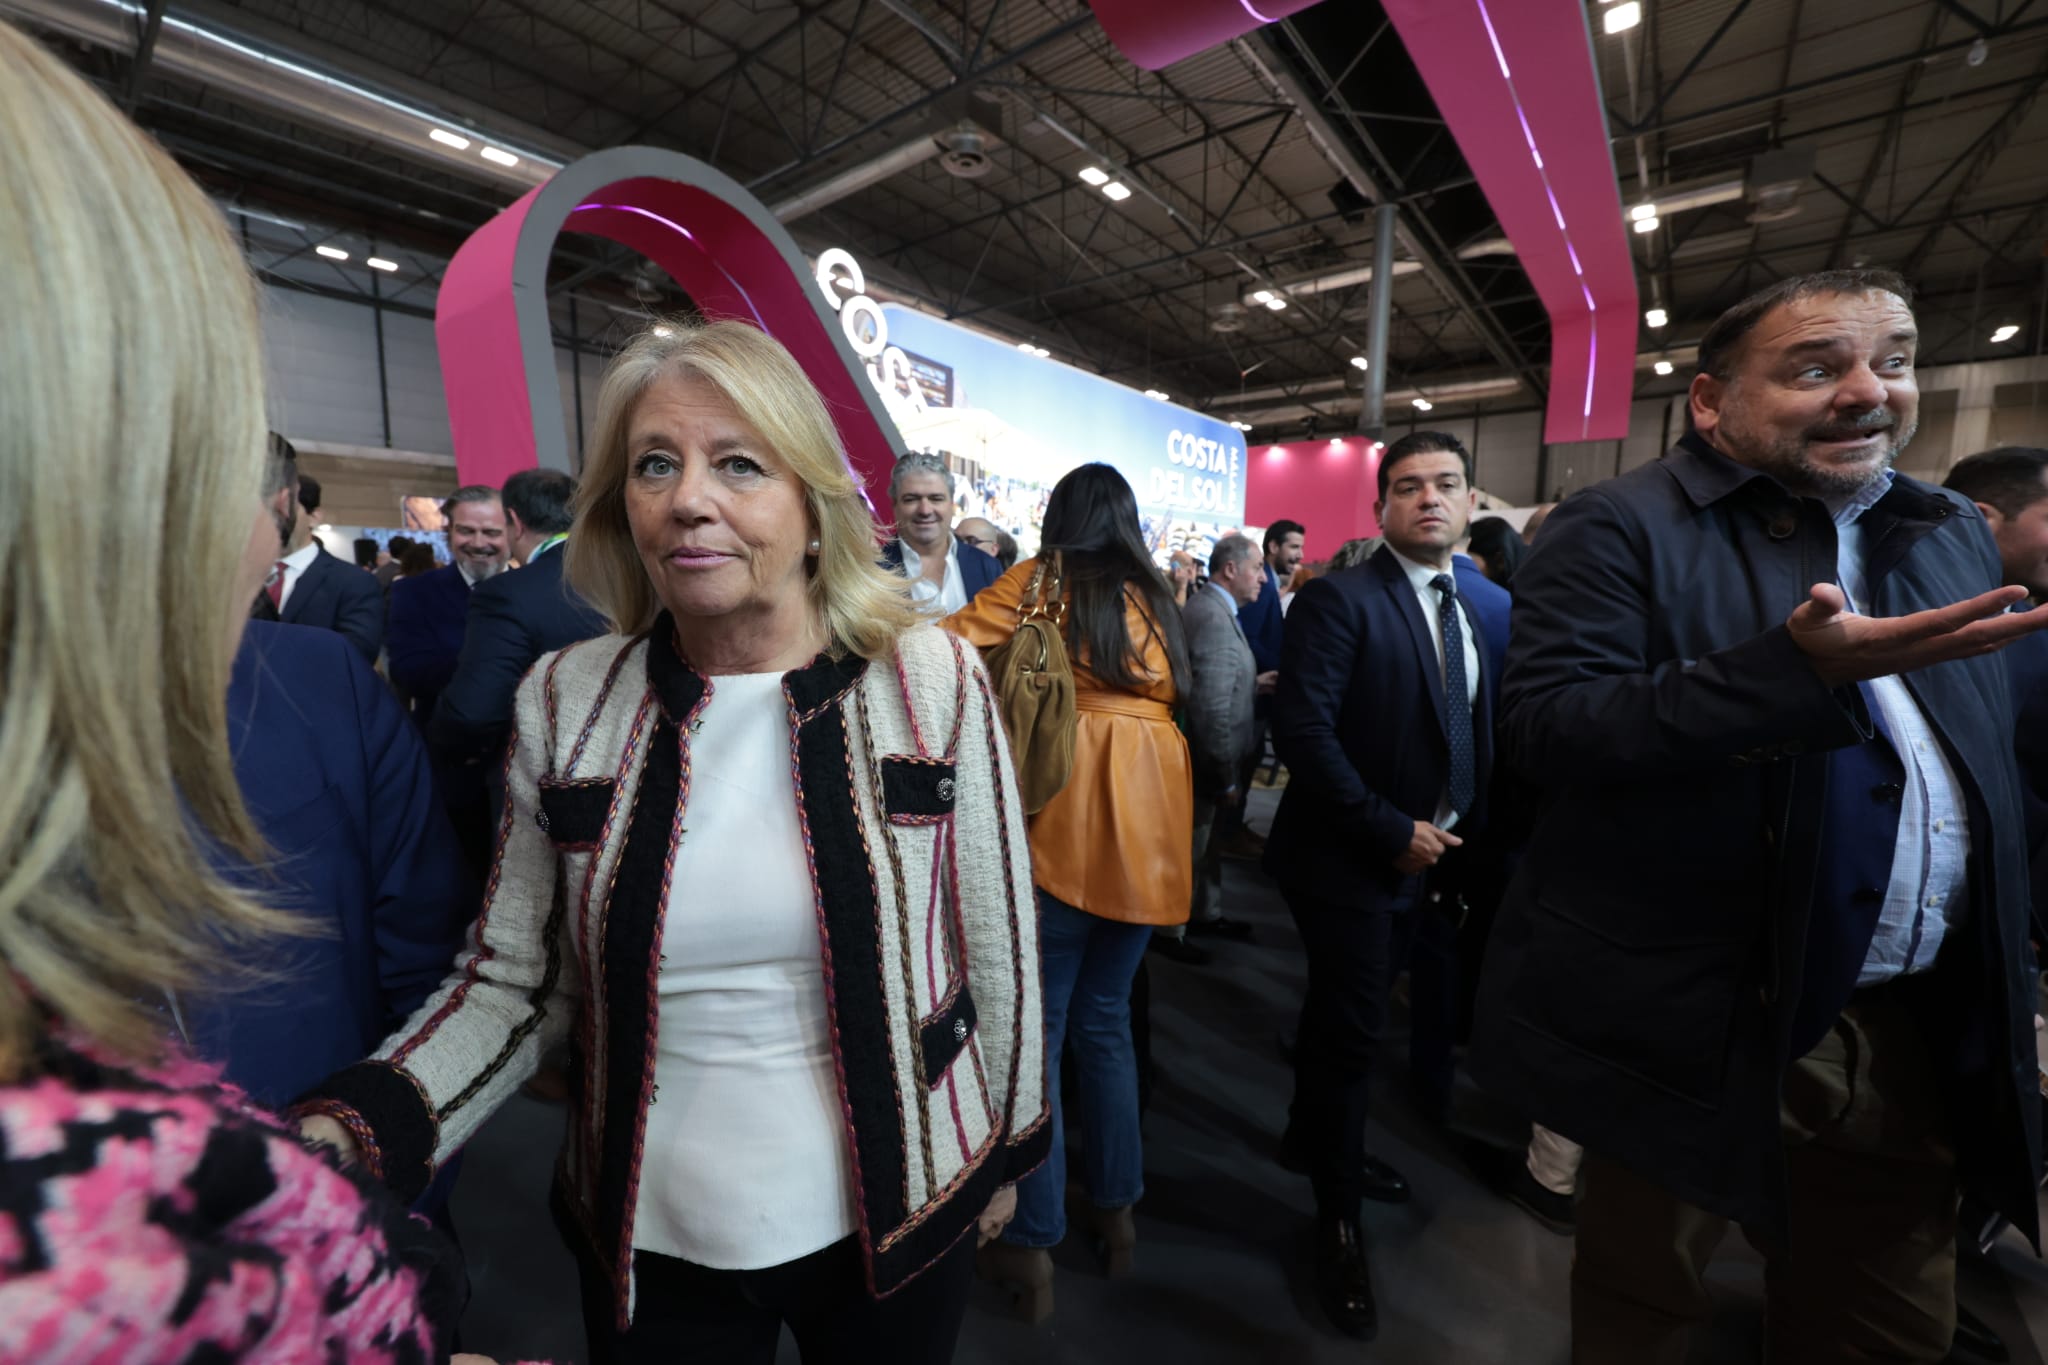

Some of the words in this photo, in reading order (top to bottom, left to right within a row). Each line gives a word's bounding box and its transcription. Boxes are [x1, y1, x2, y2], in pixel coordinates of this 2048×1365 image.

[1167, 429, 1228, 475] COSTA
[1151, 467, 1188, 507] DEL
[1191, 476, 1226, 512] SOL
